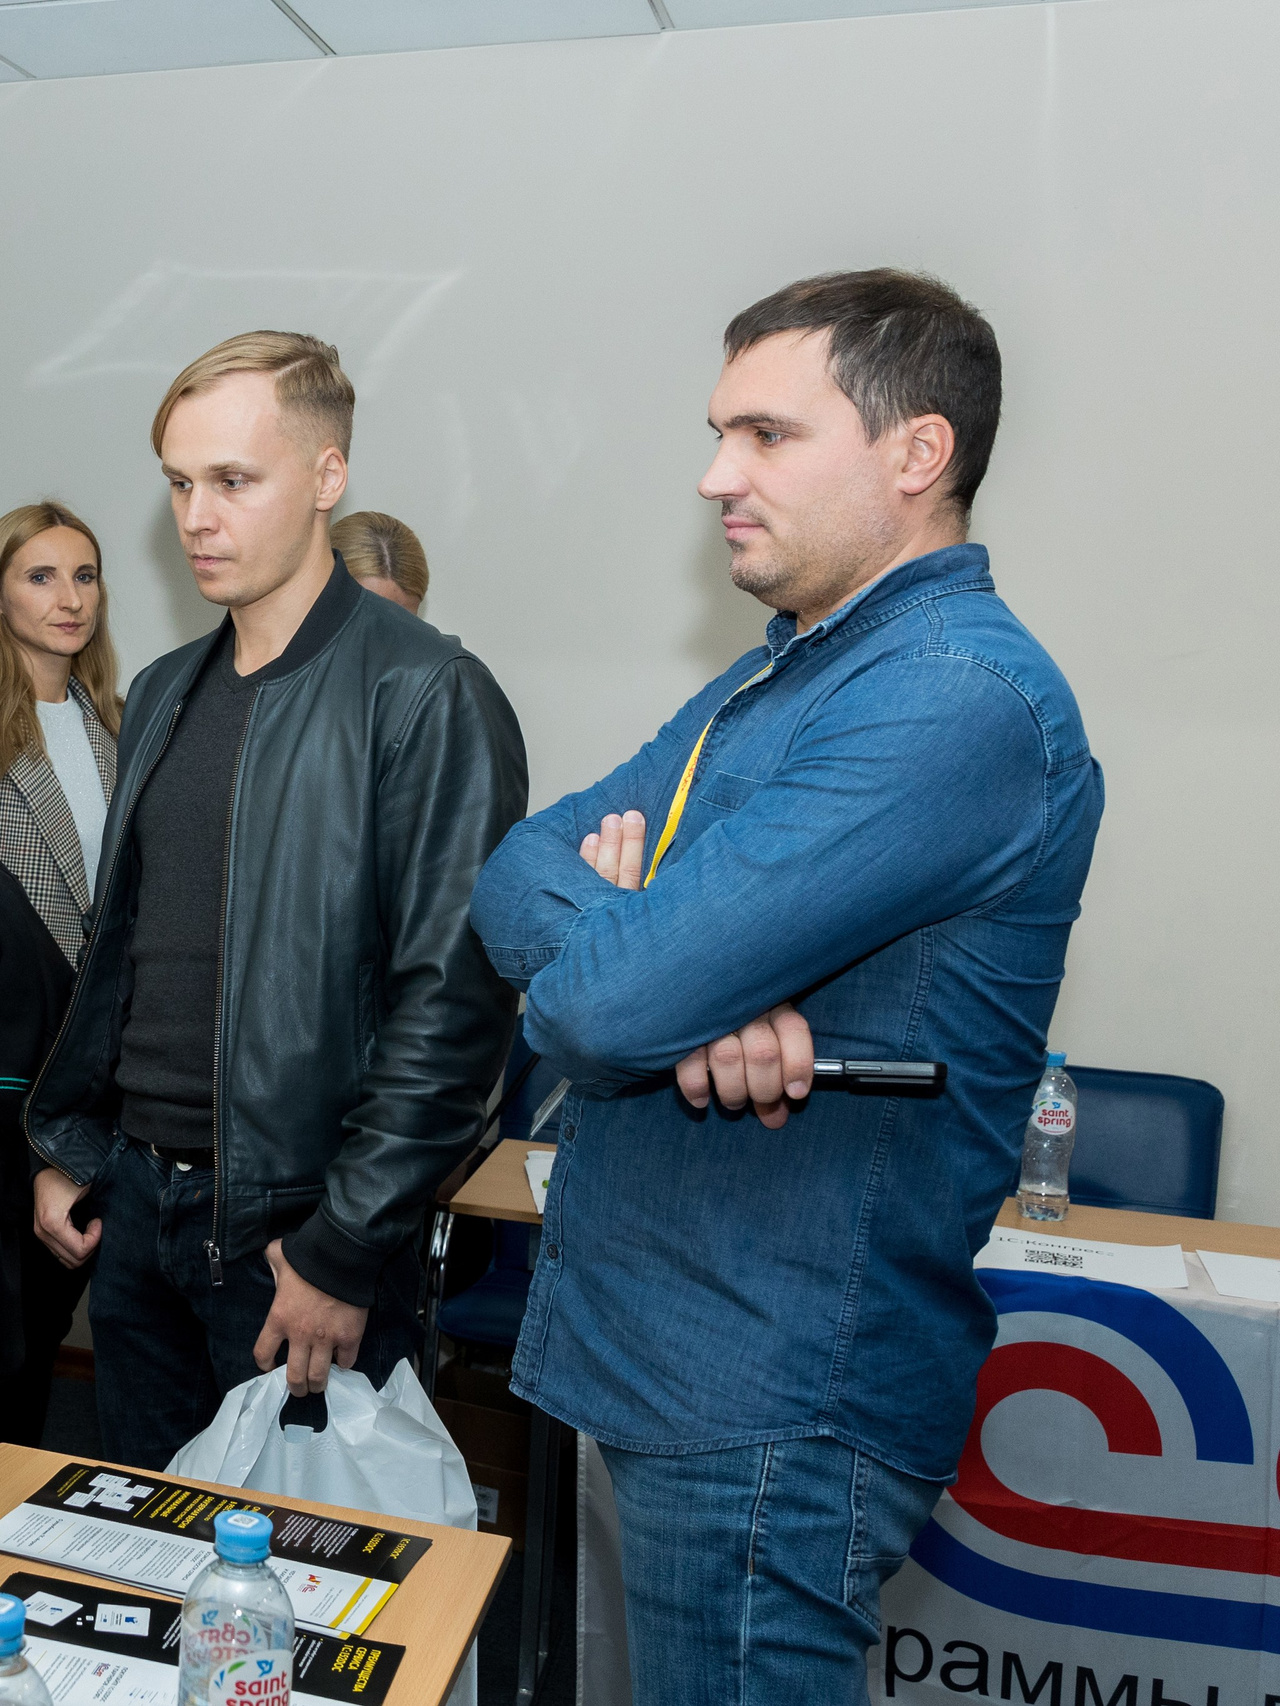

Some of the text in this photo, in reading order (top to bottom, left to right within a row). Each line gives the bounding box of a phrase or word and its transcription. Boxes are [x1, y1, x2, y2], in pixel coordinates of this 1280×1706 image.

[1041, 1108, 1069, 1117] saint
[1037, 1116, 1072, 1128] spring
[880, 1624, 1219, 1706] раммы
[235, 1671, 287, 1696] saint
